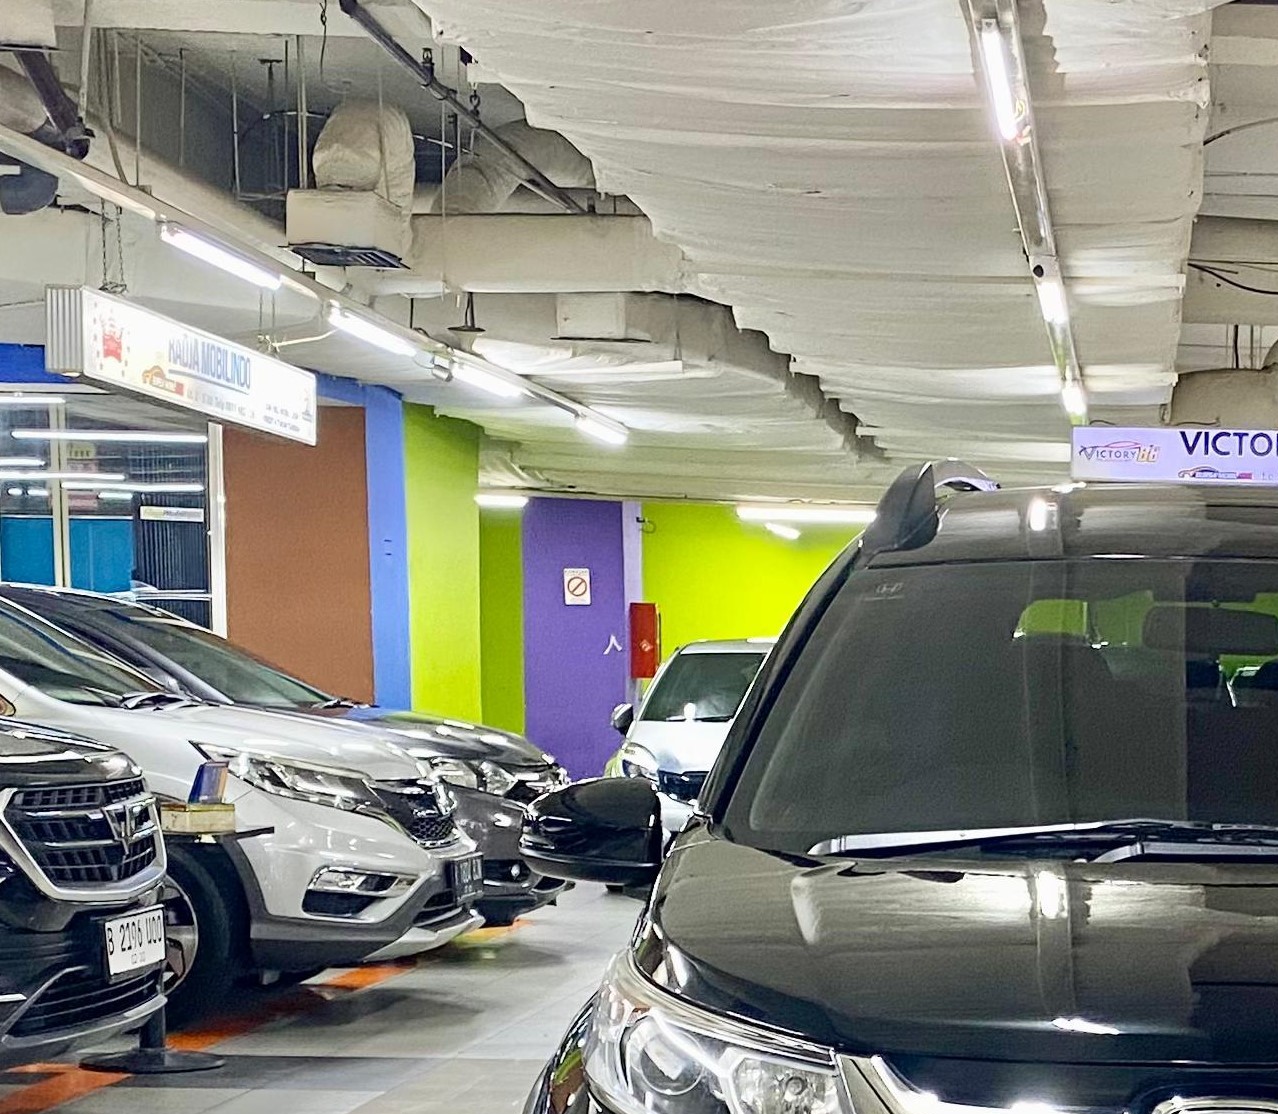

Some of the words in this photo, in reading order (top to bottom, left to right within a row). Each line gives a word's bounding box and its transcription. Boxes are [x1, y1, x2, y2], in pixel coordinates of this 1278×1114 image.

[1079, 445, 1137, 460] VICTORY
[107, 927, 115, 956] B
[120, 919, 143, 952] 2196
